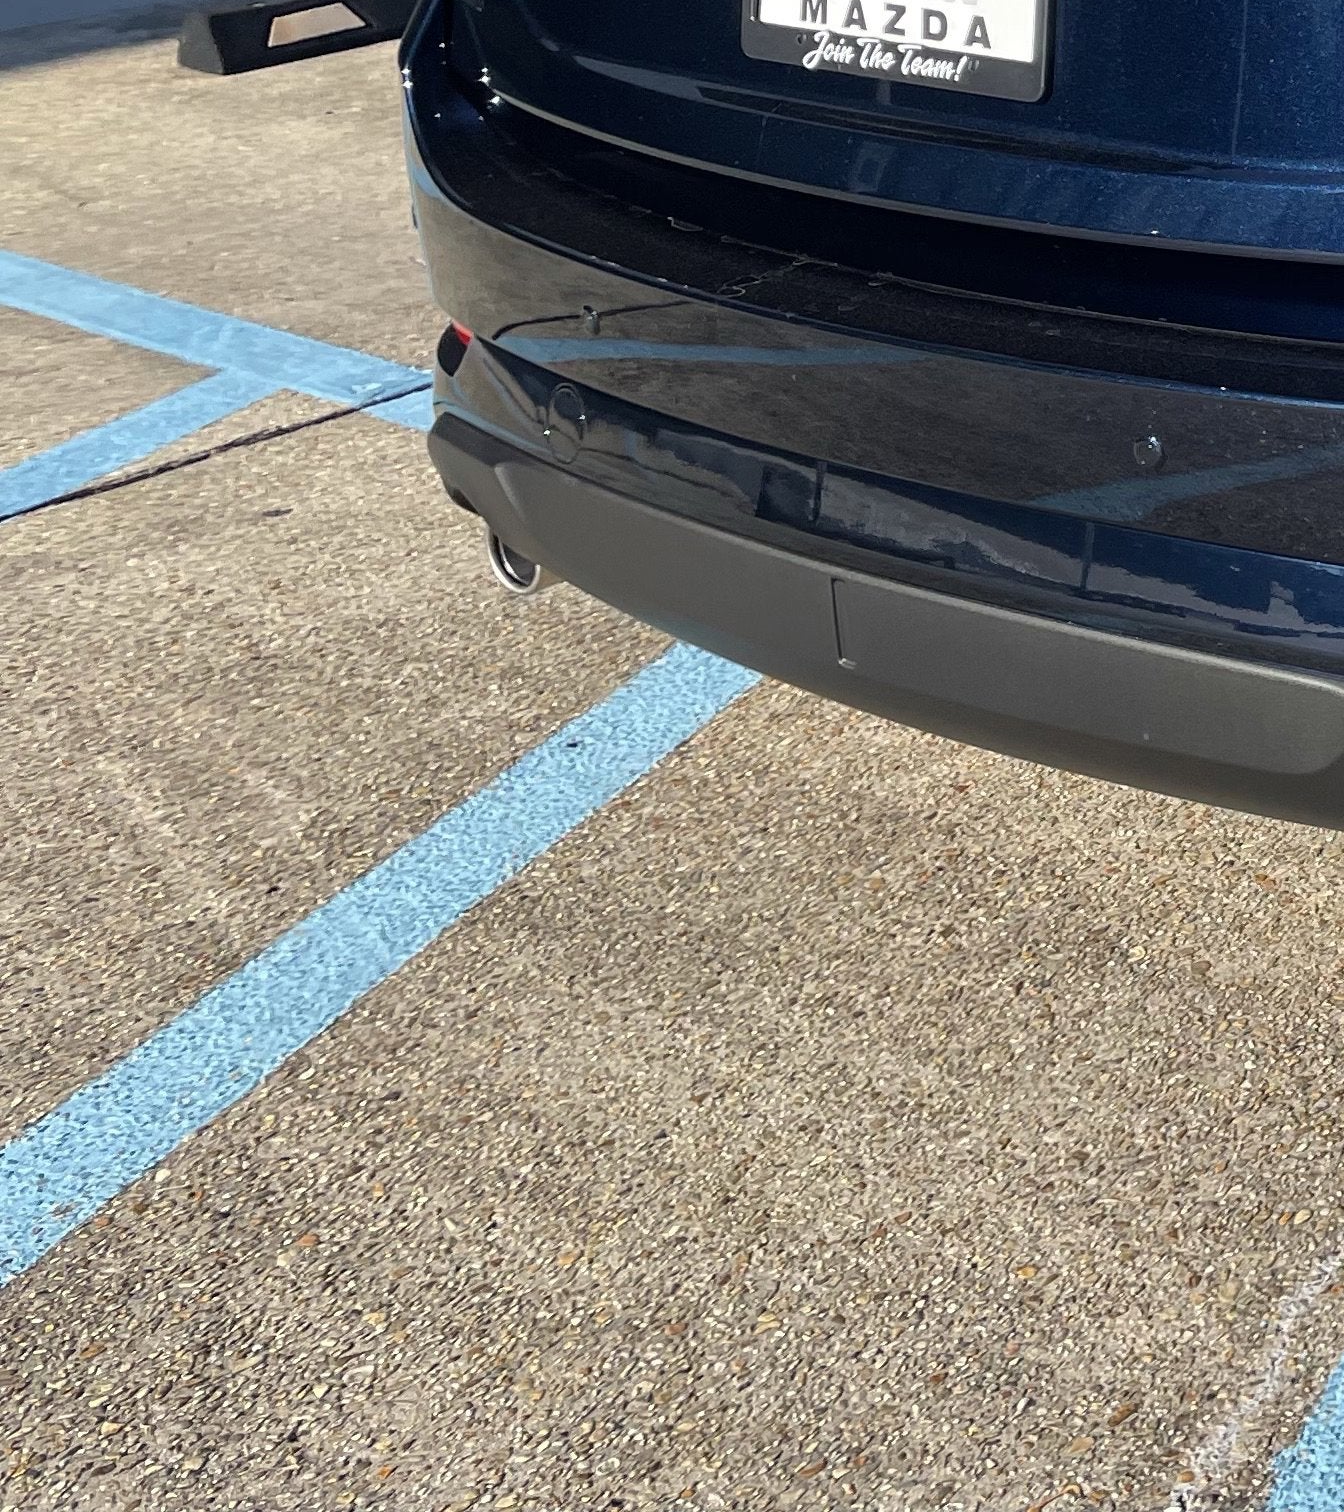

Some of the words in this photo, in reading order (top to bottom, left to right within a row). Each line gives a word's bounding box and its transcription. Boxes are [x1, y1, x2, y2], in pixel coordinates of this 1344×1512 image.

[802, 30, 855, 70] Join
[856, 37, 895, 70] The
[897, 43, 969, 82] Team!
